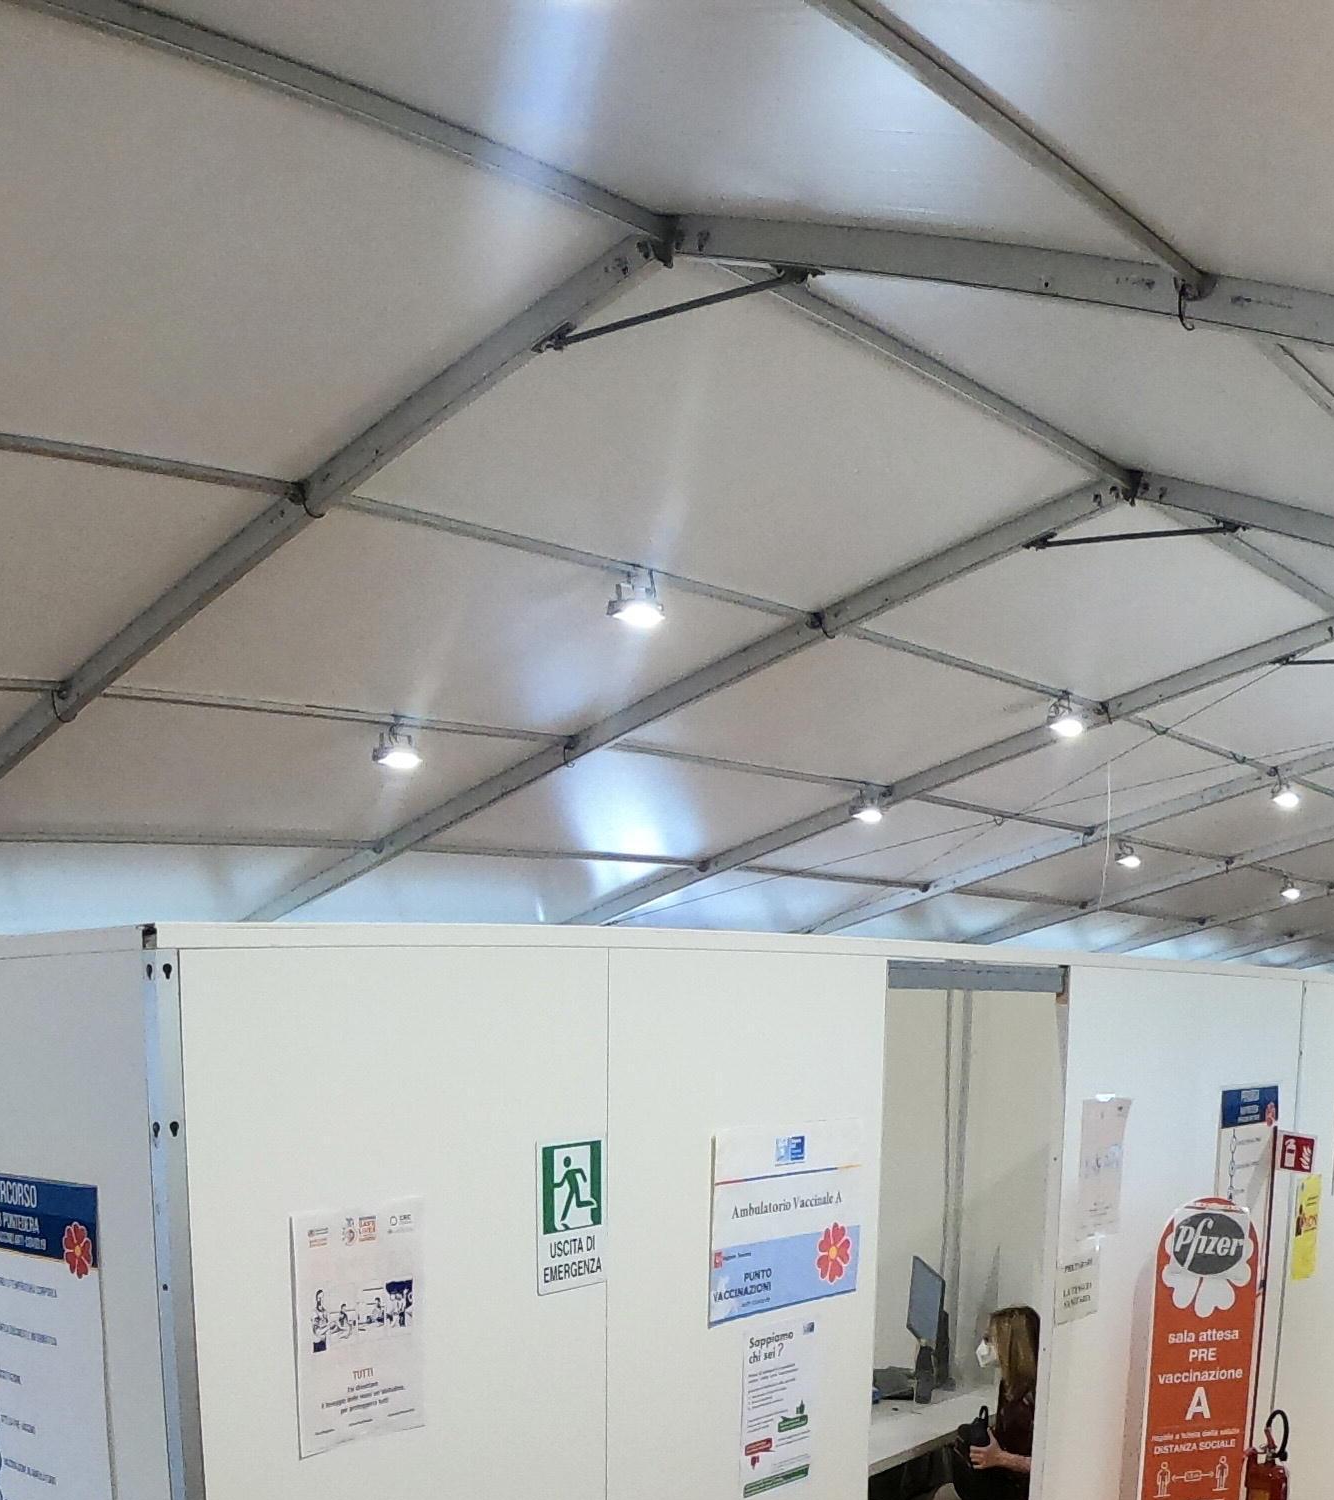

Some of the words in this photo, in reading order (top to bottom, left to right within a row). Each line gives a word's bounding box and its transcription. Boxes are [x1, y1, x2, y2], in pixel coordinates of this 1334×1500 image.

[731, 1199, 791, 1219] Ambulatorio
[793, 1191, 835, 1210] Vaccinale
[836, 1190, 843, 1204] A
[550, 1238, 584, 1258] USCITA
[587, 1235, 595, 1251] DI
[1174, 1217, 1244, 1270] Pfizer
[544, 1257, 602, 1283] EMERGENZA
[744, 1268, 772, 1282] PUNTO
[713, 1282, 771, 1302] VACCINAZIONI
[749, 1331, 793, 1349] Sappiamo
[1168, 1330, 1195, 1343] sala
[1199, 1329, 1239, 1341] attesa
[749, 1350, 760, 1364] chi
[1189, 1348, 1217, 1362] PRE
[353, 1367, 374, 1380] TUTTI
[1158, 1368, 1243, 1384] vaccinazione
[1185, 1386, 1211, 1420] A
[1154, 1444, 1197, 1454] DISTANZA
[1199, 1439, 1236, 1450] SOCIALE
